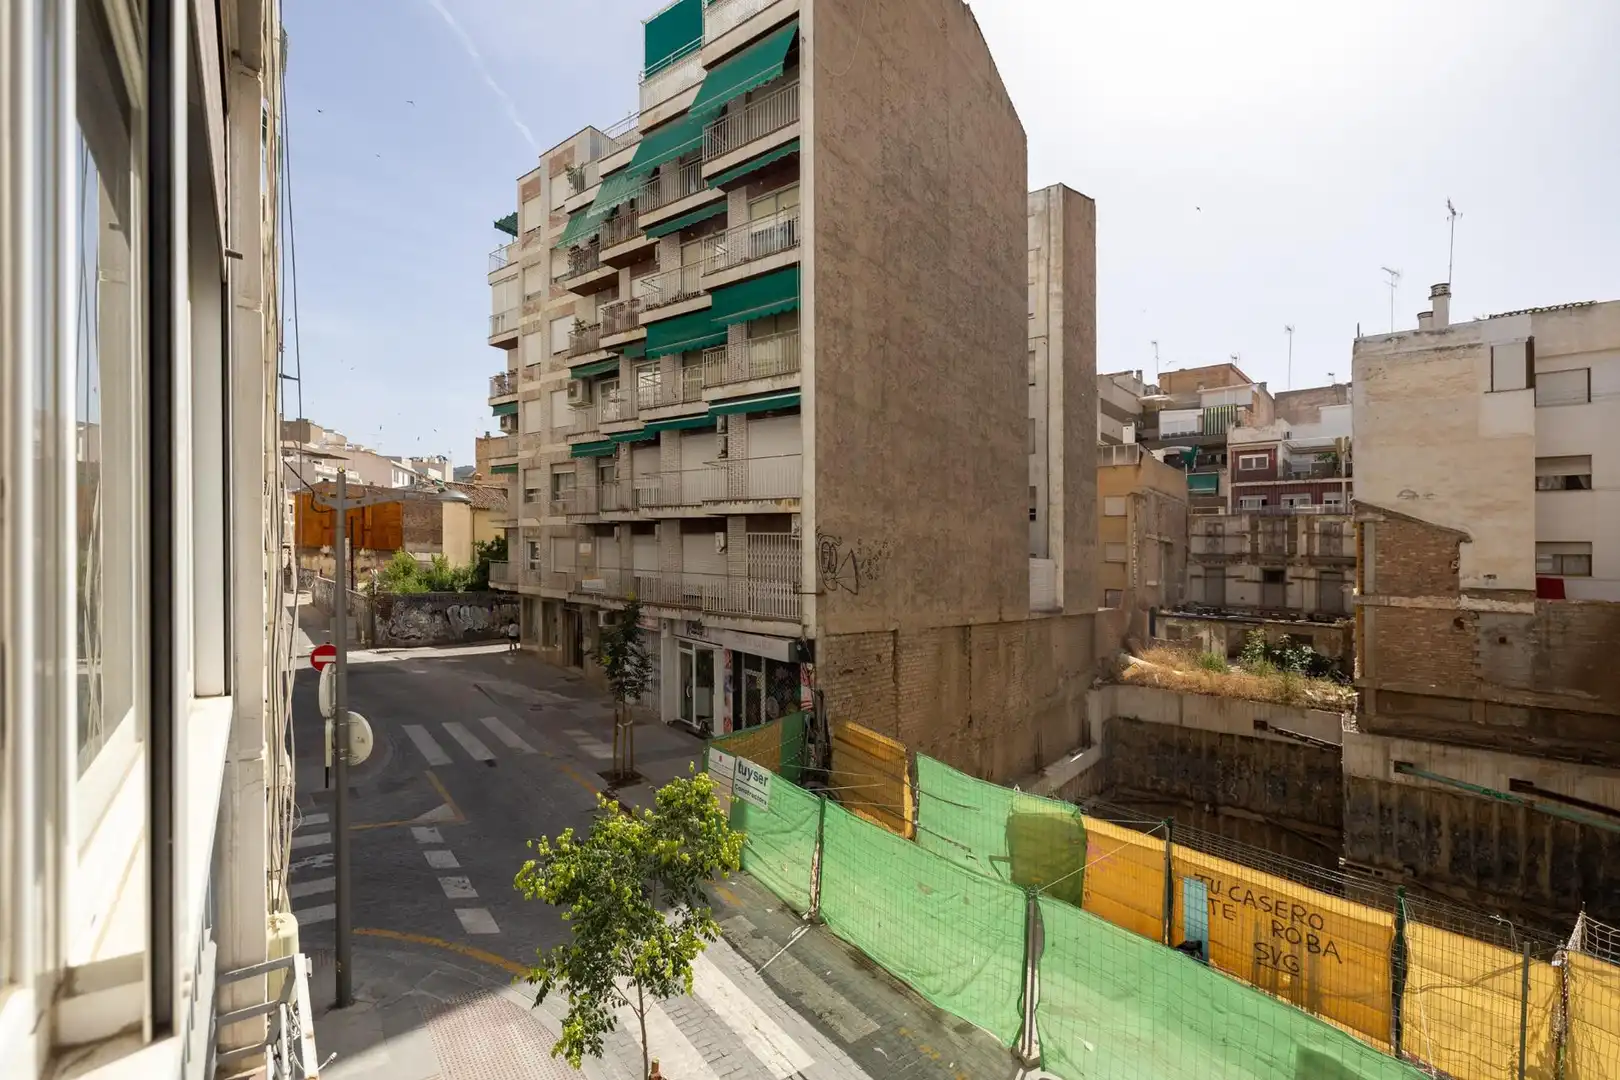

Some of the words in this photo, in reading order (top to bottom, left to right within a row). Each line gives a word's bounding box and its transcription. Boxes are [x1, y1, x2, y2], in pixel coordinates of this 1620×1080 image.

[738, 760, 768, 787] tuyser
[1208, 897, 1237, 921] TE
[1271, 919, 1343, 965] ROBA
[1228, 886, 1324, 931] CASERO
